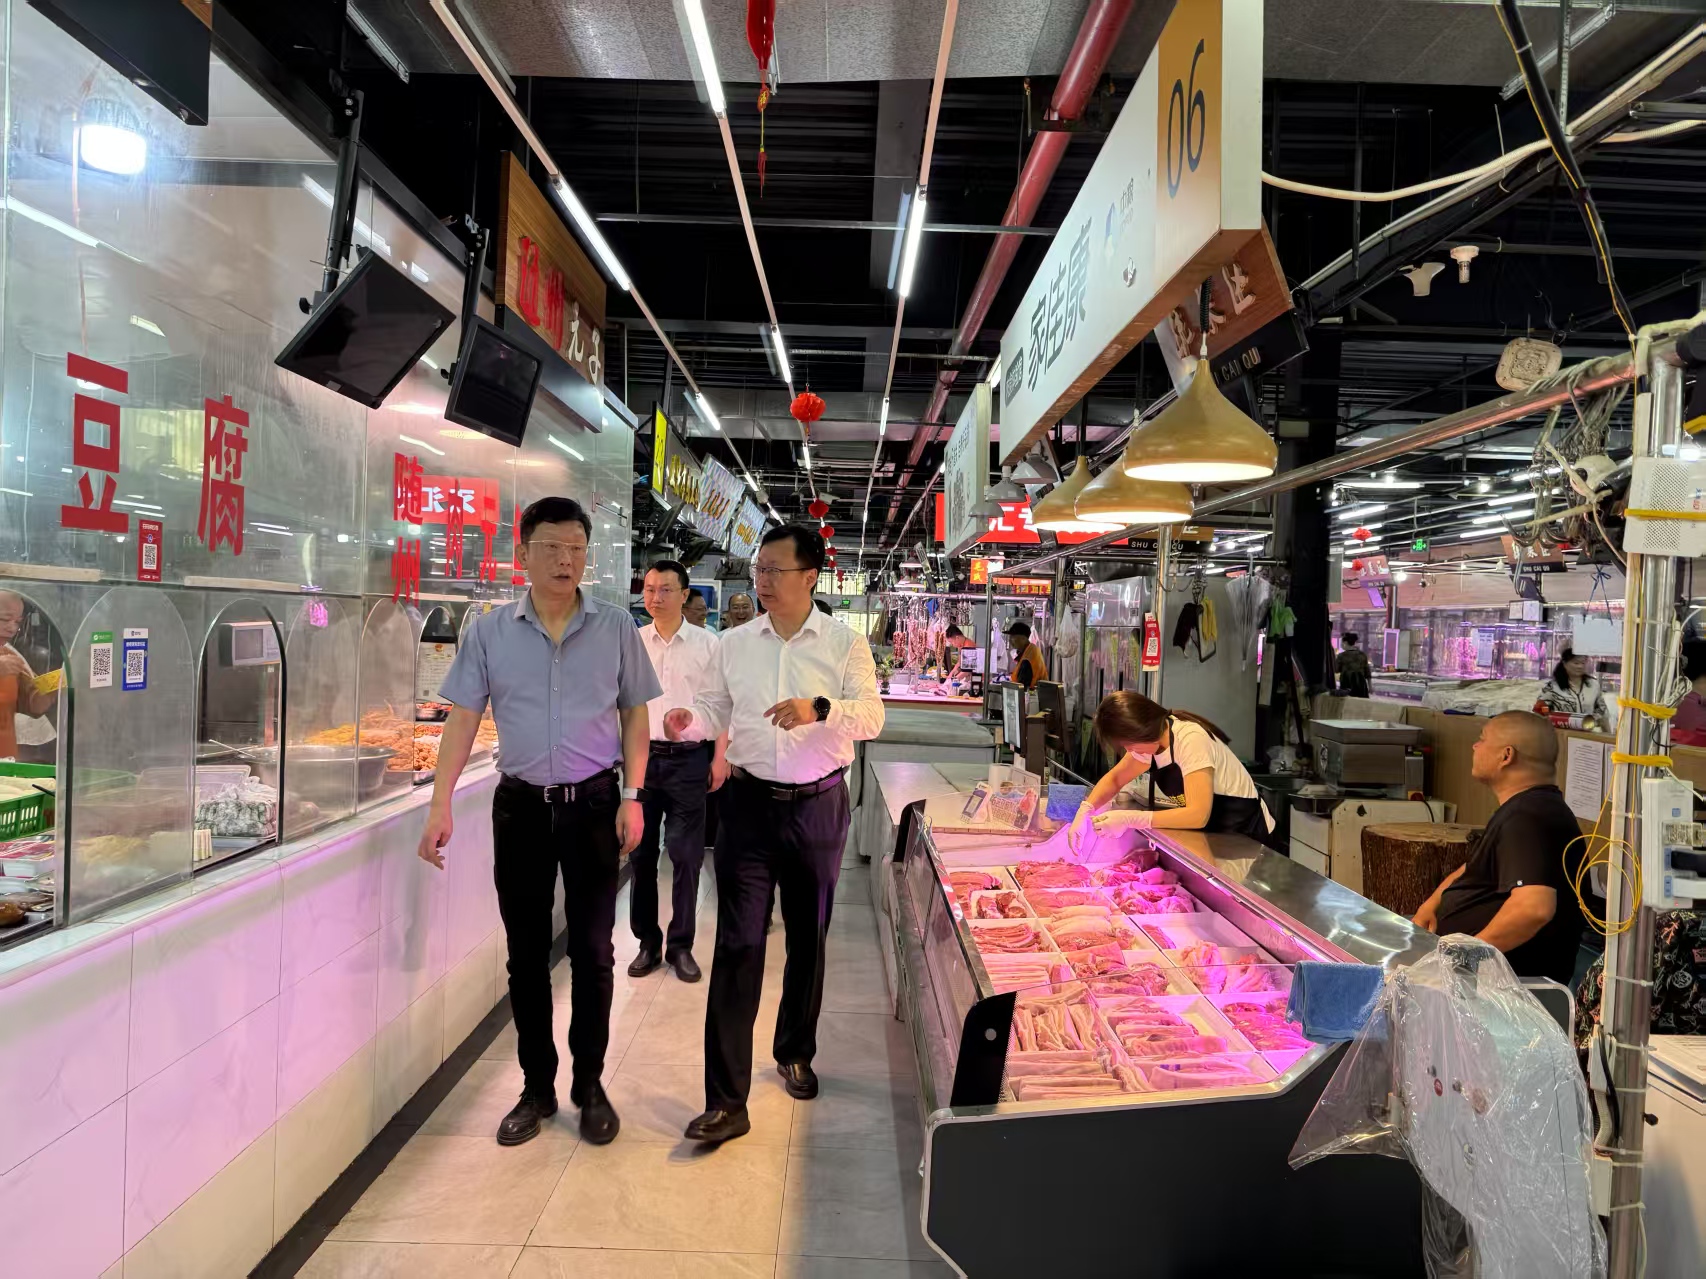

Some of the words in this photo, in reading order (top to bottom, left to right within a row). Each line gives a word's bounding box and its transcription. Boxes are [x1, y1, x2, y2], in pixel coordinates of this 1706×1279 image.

[1167, 39, 1206, 199] 06
[1242, 346, 1262, 370] QU
[60, 351, 250, 557] 豆腐
[1131, 541, 1149, 549] SHU
